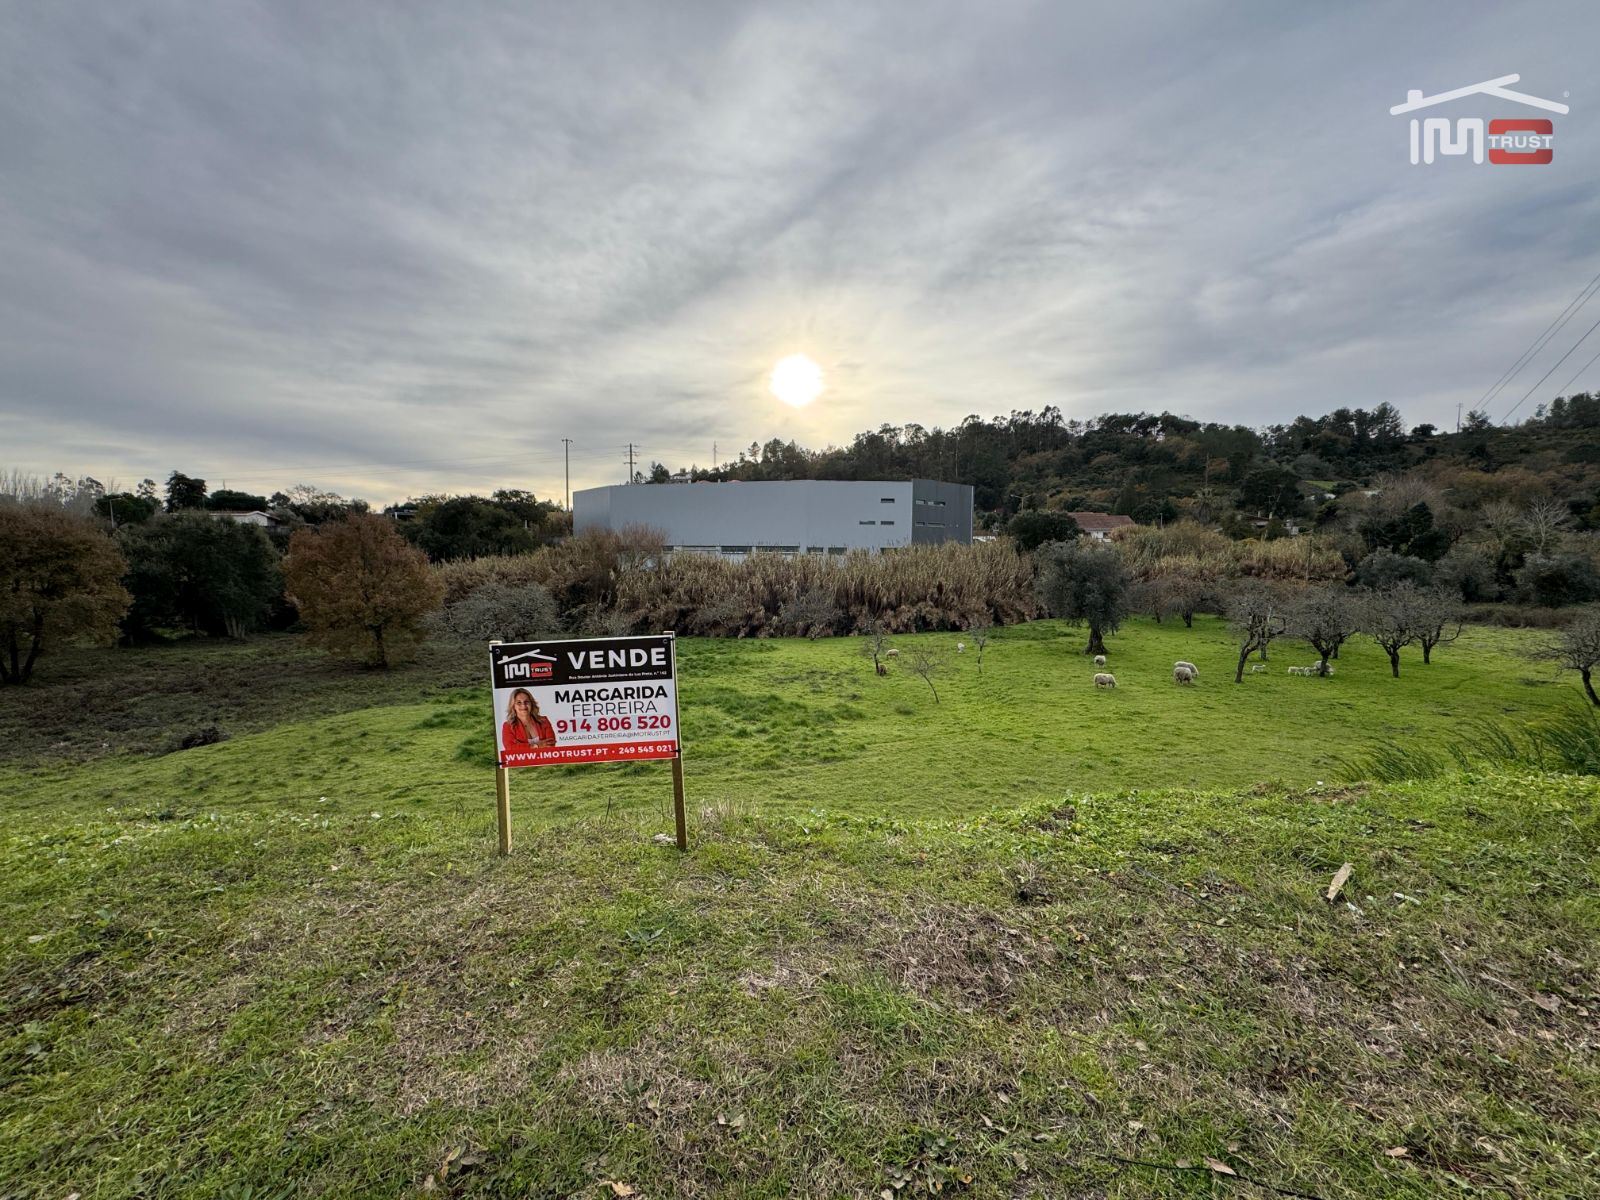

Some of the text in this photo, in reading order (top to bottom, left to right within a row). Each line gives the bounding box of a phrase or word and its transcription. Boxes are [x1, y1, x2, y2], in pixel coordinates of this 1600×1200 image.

[567, 647, 667, 670] VENDE
[555, 685, 668, 703] MARGARIDA
[572, 700, 658, 717] FERREIRA
[556, 715, 671, 733] 914 806 520
[505, 744, 673, 761] WWW.IMOTRUST.PT 249 545 021
